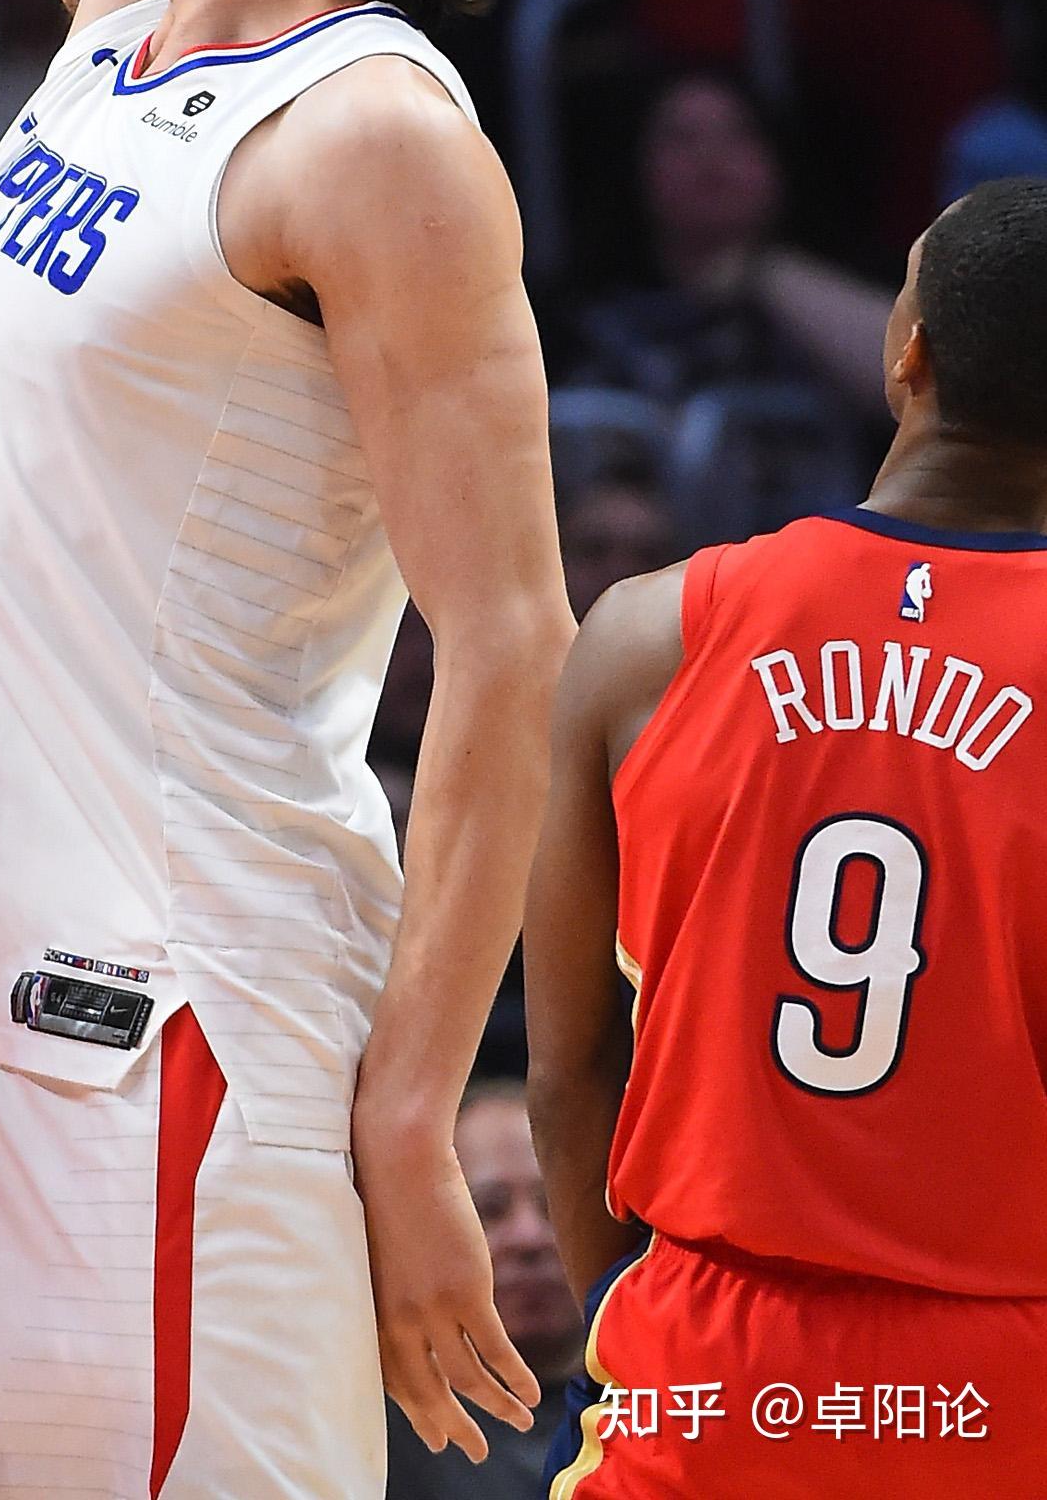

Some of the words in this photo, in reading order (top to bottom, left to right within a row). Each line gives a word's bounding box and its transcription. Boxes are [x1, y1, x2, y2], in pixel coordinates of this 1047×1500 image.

[141, 107, 198, 143] bumble
[751, 640, 1033, 771] RONDO
[771, 812, 928, 1097] 9
